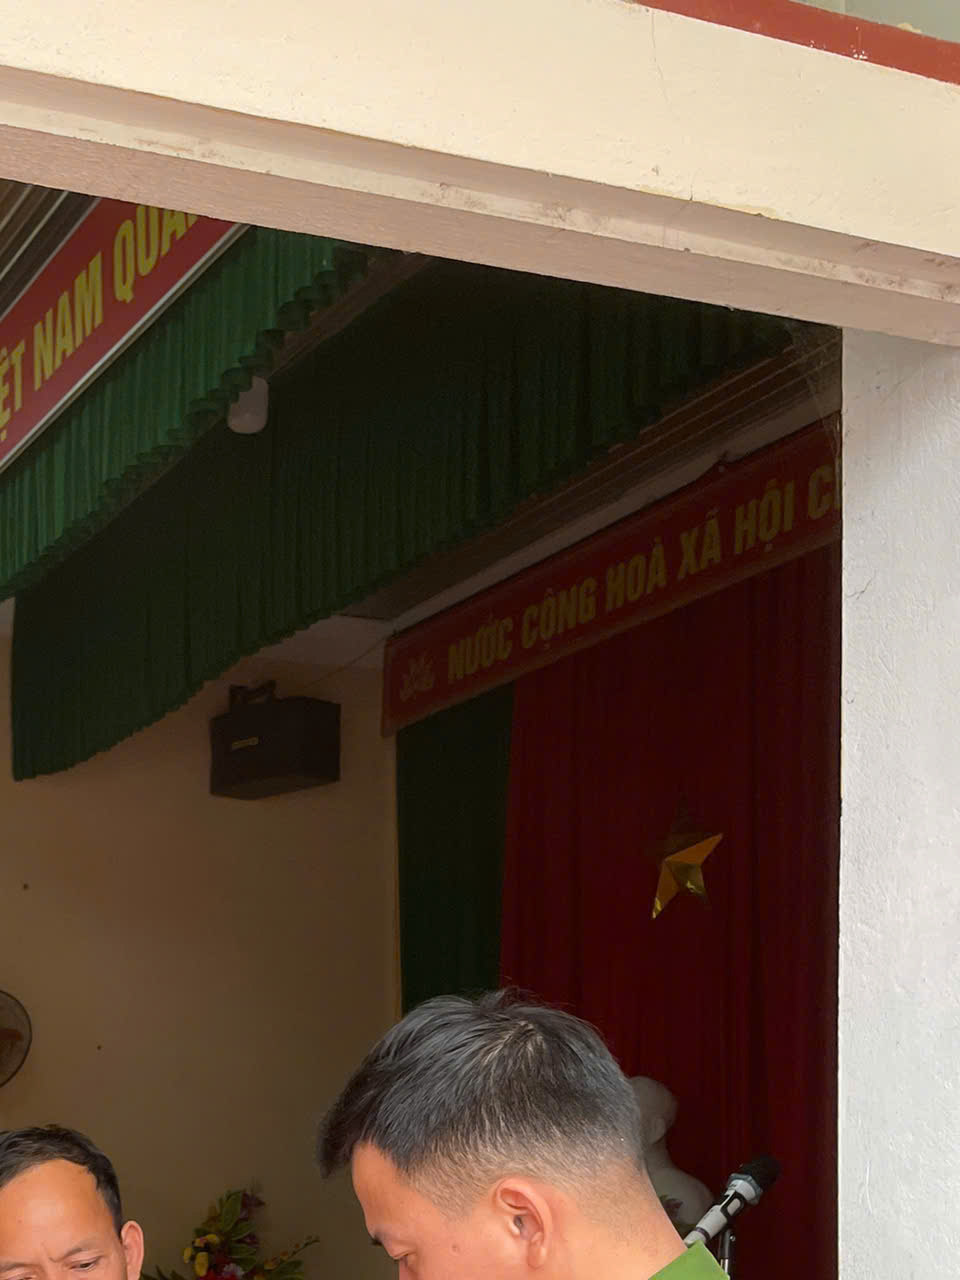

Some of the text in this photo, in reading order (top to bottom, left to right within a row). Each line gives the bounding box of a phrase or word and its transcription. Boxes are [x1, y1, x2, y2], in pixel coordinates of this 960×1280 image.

[33, 251, 104, 391] NAM
[113, 204, 198, 304] QUA
[448, 615, 513, 684] NƯỚC
[521, 577, 597, 650] CỘNG
[677, 508, 721, 581] XÃ
[734, 478, 795, 551] HỘI
